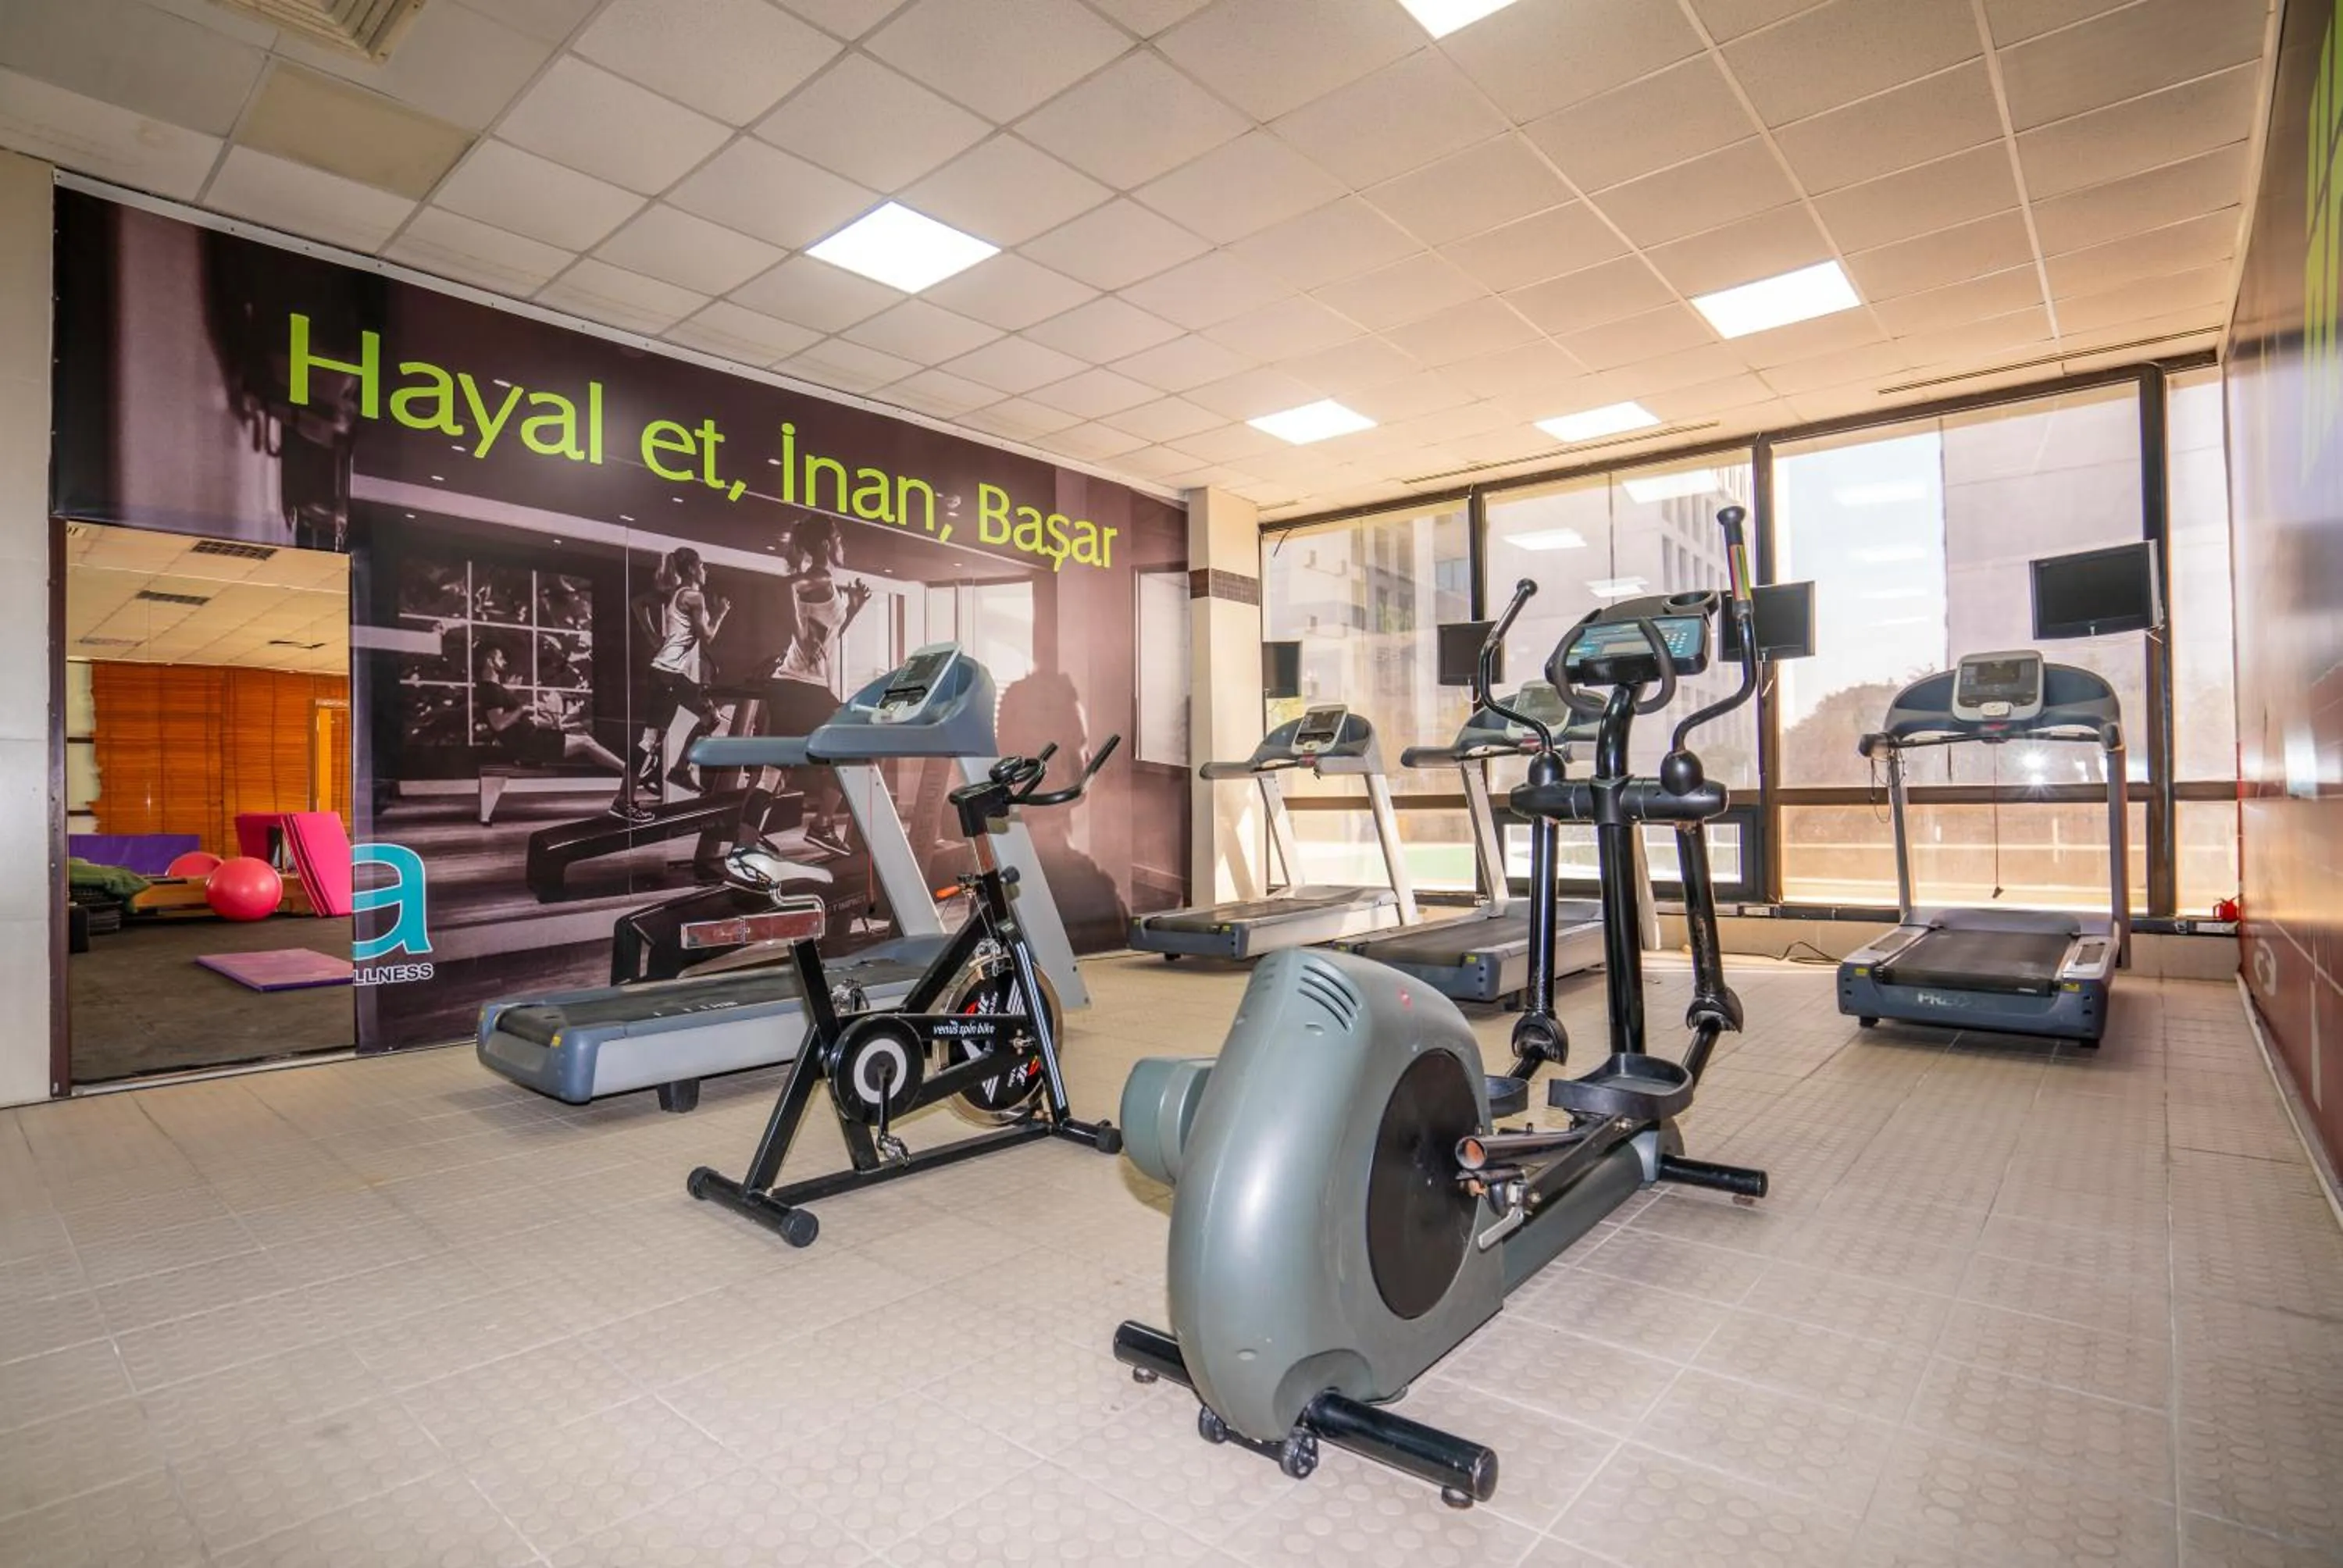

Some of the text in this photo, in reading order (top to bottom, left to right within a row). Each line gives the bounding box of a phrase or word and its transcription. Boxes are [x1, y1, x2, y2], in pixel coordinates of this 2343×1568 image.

[289, 313, 1118, 572] Hayal et, İnan, Başar
[933, 1021, 996, 1038] venus spin bike
